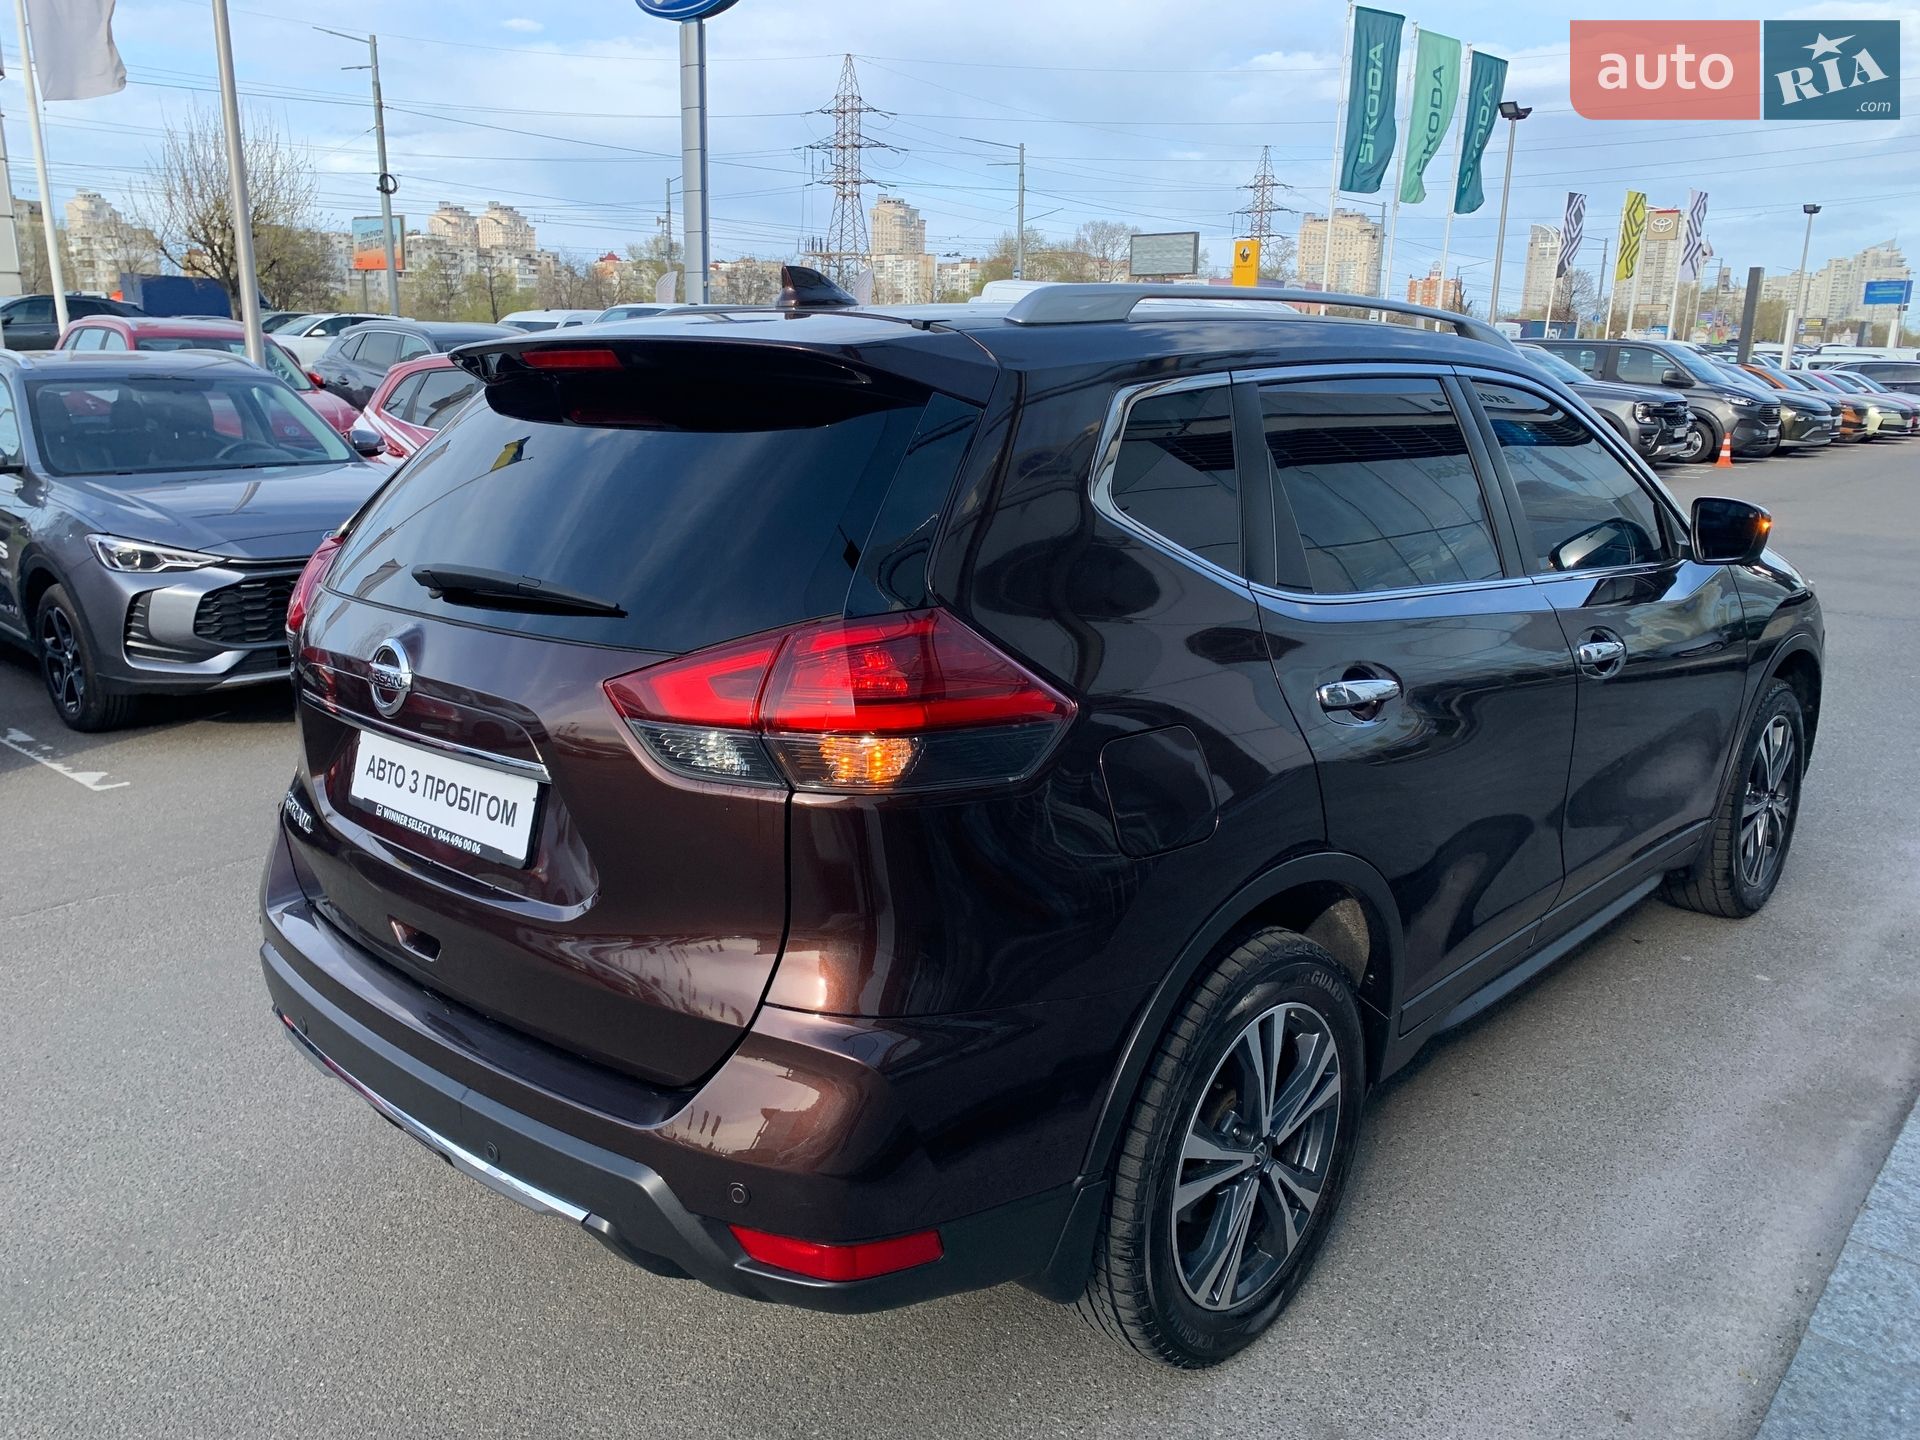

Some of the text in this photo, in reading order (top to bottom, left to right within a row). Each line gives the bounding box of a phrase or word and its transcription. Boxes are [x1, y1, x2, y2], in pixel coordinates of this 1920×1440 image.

[366, 755, 518, 828] АВТО З ПРОБІГОМ
[383, 807, 481, 855] WINNER SELECT 044 496 00 06
